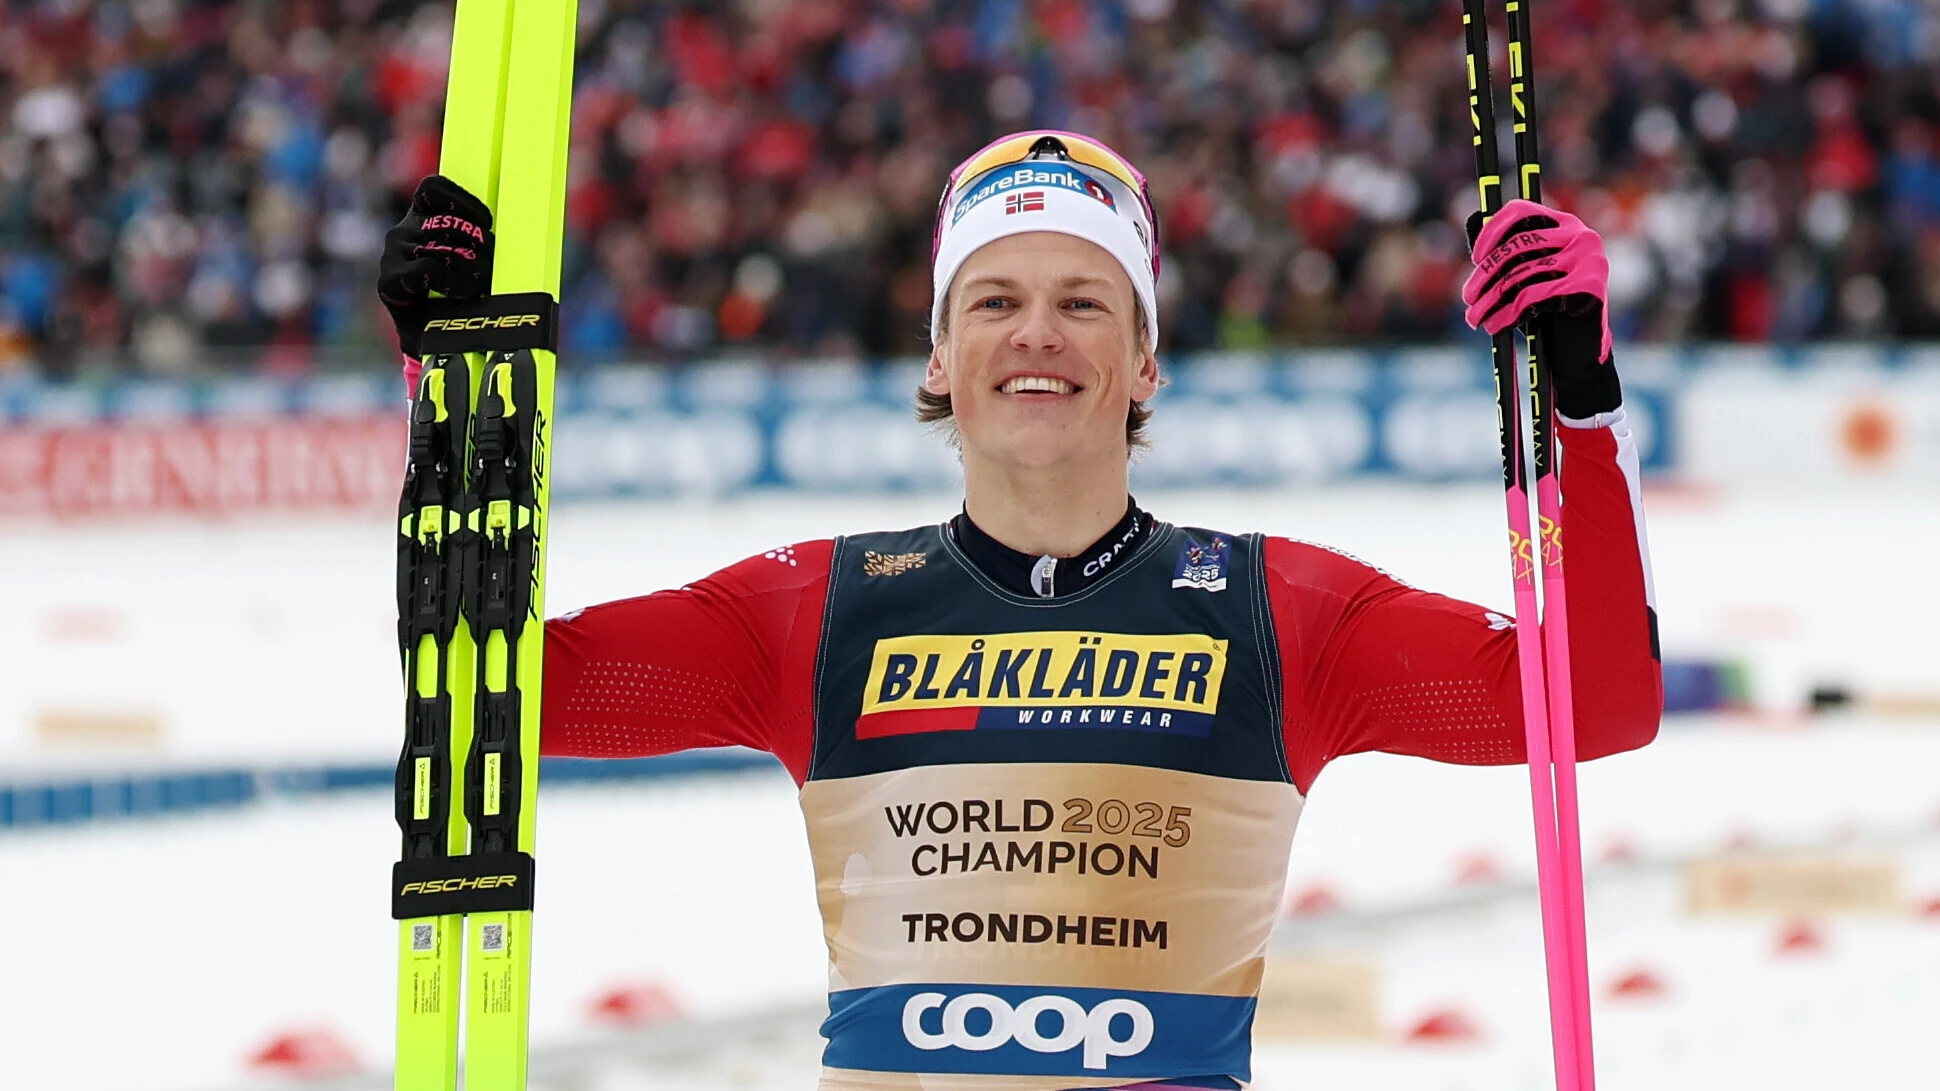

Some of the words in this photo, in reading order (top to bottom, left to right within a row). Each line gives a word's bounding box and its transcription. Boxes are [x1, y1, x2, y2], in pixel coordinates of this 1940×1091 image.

[954, 169, 1083, 221] SpareBank
[420, 214, 485, 246] HESTRA
[1481, 232, 1548, 274] HESTRA
[424, 314, 541, 332] FISCHER
[528, 409, 546, 622] FISCHER
[877, 637, 1214, 706] BLÅKLÄDER
[1017, 708, 1174, 728] WORKWEAR
[488, 766, 496, 810] FISCHER
[884, 799, 1055, 838] WORLD
[1061, 797, 1192, 849] 2025
[911, 841, 1159, 879] CHAMPION
[401, 875, 518, 896] FISCHER
[902, 912, 1168, 950] TRONDHEIM
[902, 992, 1154, 1070] coop
